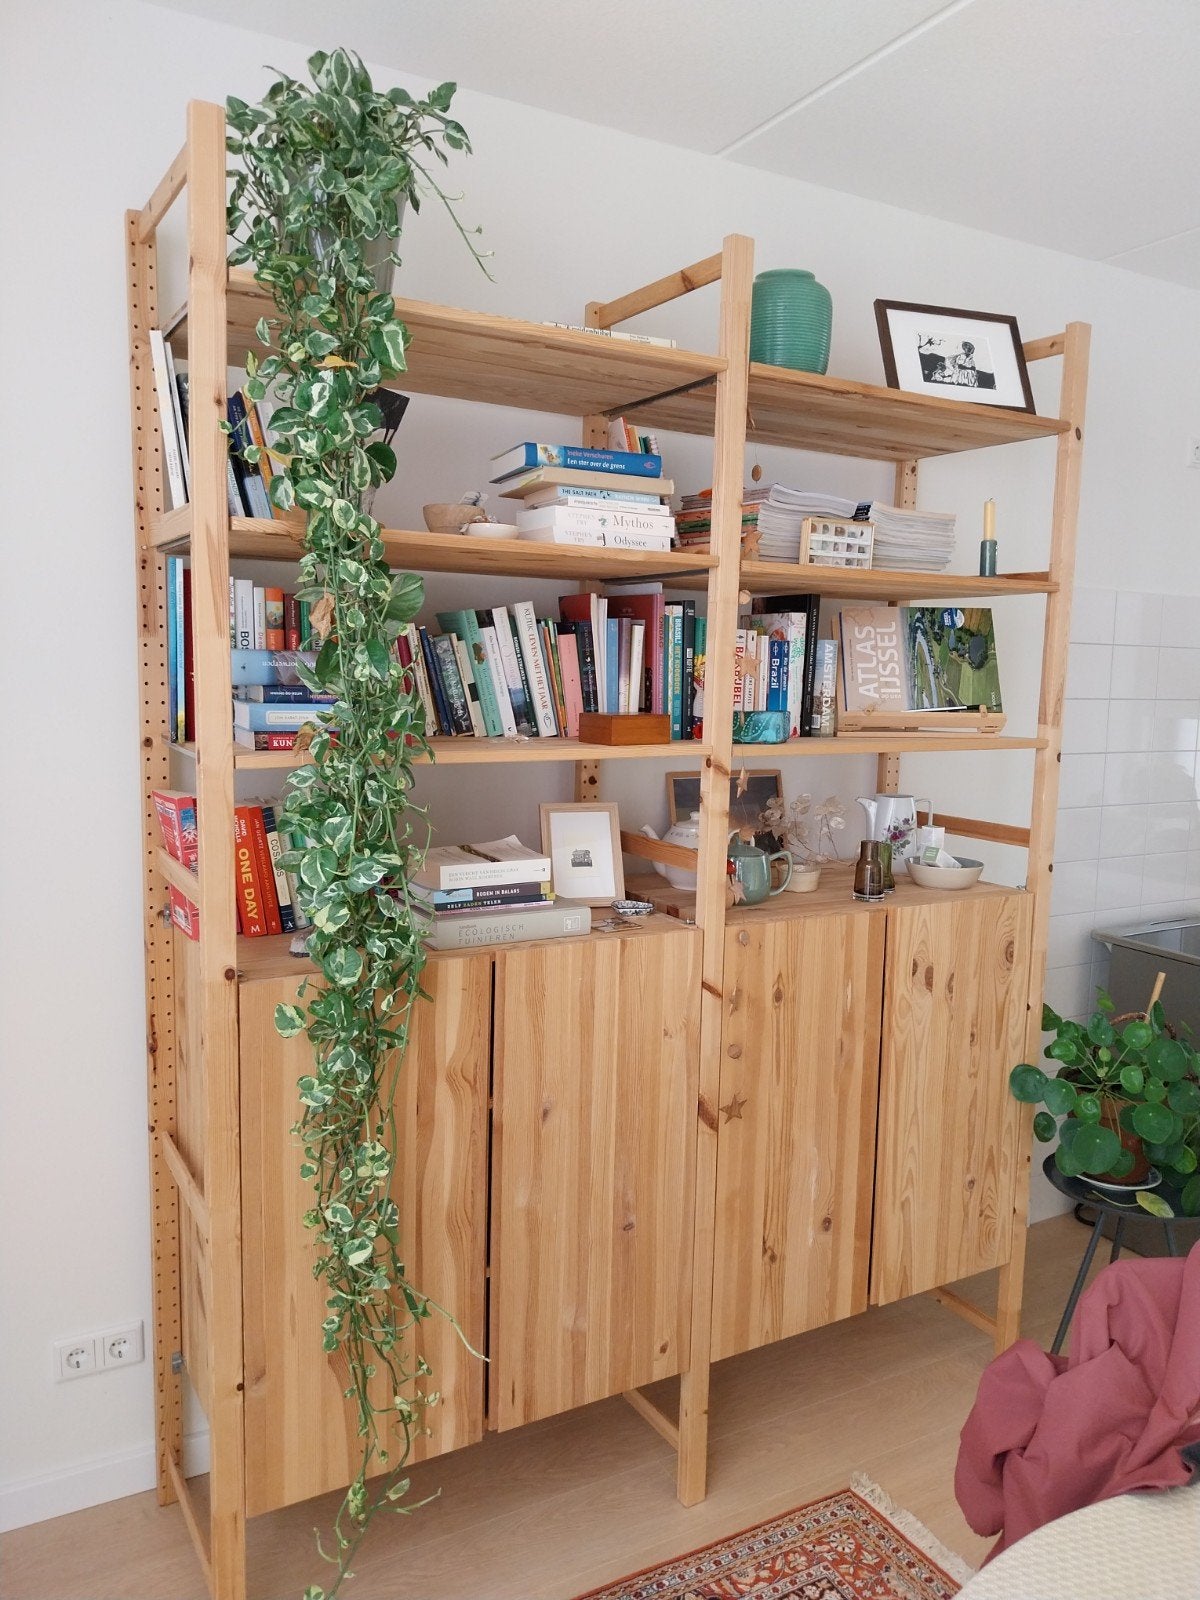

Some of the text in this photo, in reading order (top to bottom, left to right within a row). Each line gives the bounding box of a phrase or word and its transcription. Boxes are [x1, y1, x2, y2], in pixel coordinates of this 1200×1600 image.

[613, 515, 654, 530] Mythos
[614, 536, 647, 547] Odyssee
[524, 608, 533, 631] KUTIK
[529, 634, 537, 657] LEVEN
[855, 626, 879, 698] ATLAS
[877, 621, 901, 694] IJSSEL
[536, 676, 544, 690] HET
[771, 658, 780, 688] Brazil
[822, 643, 832, 726] AMSTERDAM
[539, 692, 548, 710] JAAR
[239, 848, 258, 919] ONE DAY
[458, 924, 524, 937] ECOLOGISCH
[458, 933, 515, 944] TUINIEREN
